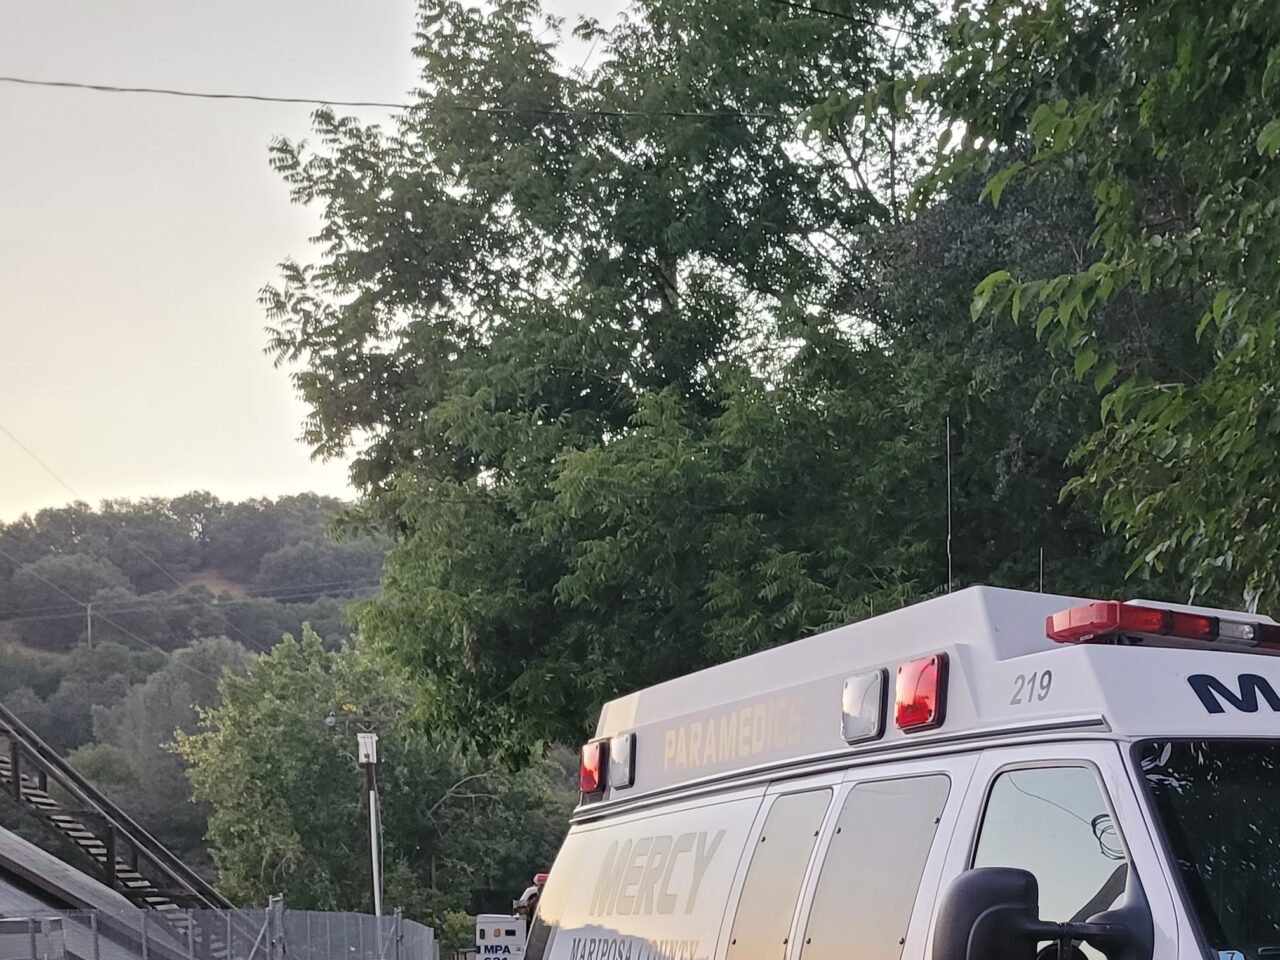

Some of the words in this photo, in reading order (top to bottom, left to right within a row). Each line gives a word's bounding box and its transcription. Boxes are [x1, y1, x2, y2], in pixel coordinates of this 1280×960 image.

[1010, 670, 1052, 705] 219
[588, 829, 728, 917] MERCY
[484, 945, 511, 954] MPA
